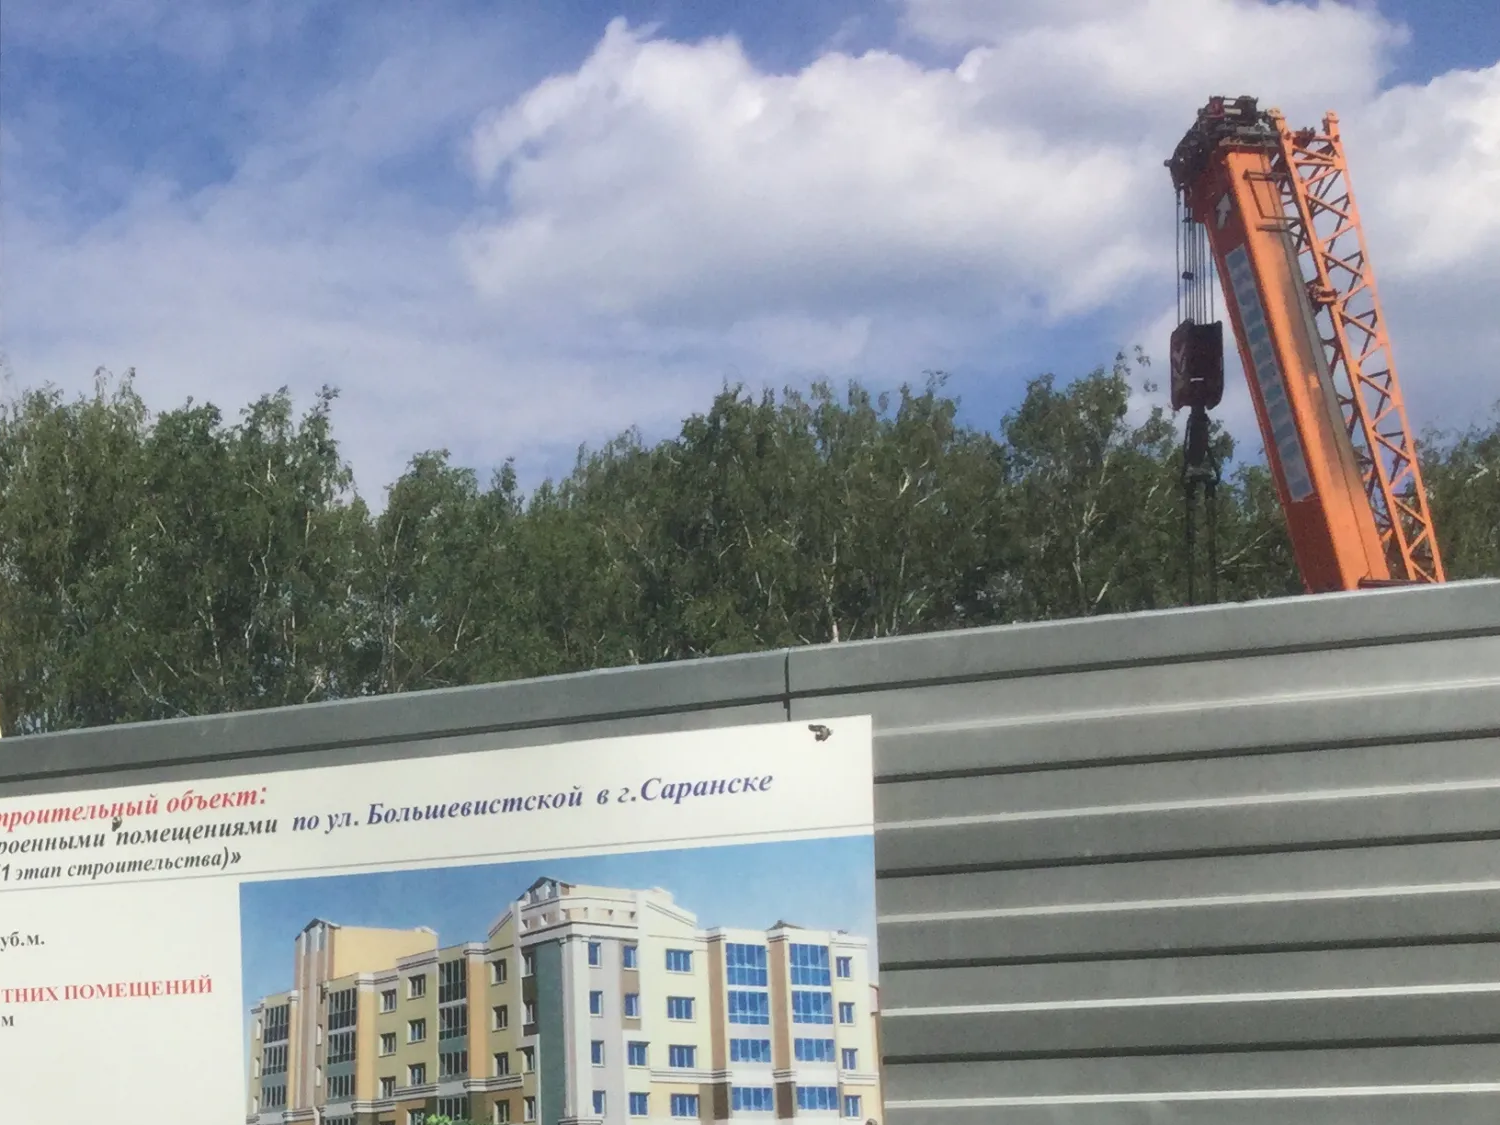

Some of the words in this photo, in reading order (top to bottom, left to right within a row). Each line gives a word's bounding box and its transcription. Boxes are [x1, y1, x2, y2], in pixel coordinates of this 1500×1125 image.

[165, 786, 267, 814] объект:
[115, 817, 278, 847] помещениями
[292, 814, 320, 832] по
[323, 812, 360, 835] ул.
[366, 785, 583, 826] Большевистской
[596, 788, 611, 806] в
[15, 865, 62, 881] этап
[67, 847, 242, 880] строительства)»
[64, 974, 213, 1001] ПОМЕЩЕНИЙ
